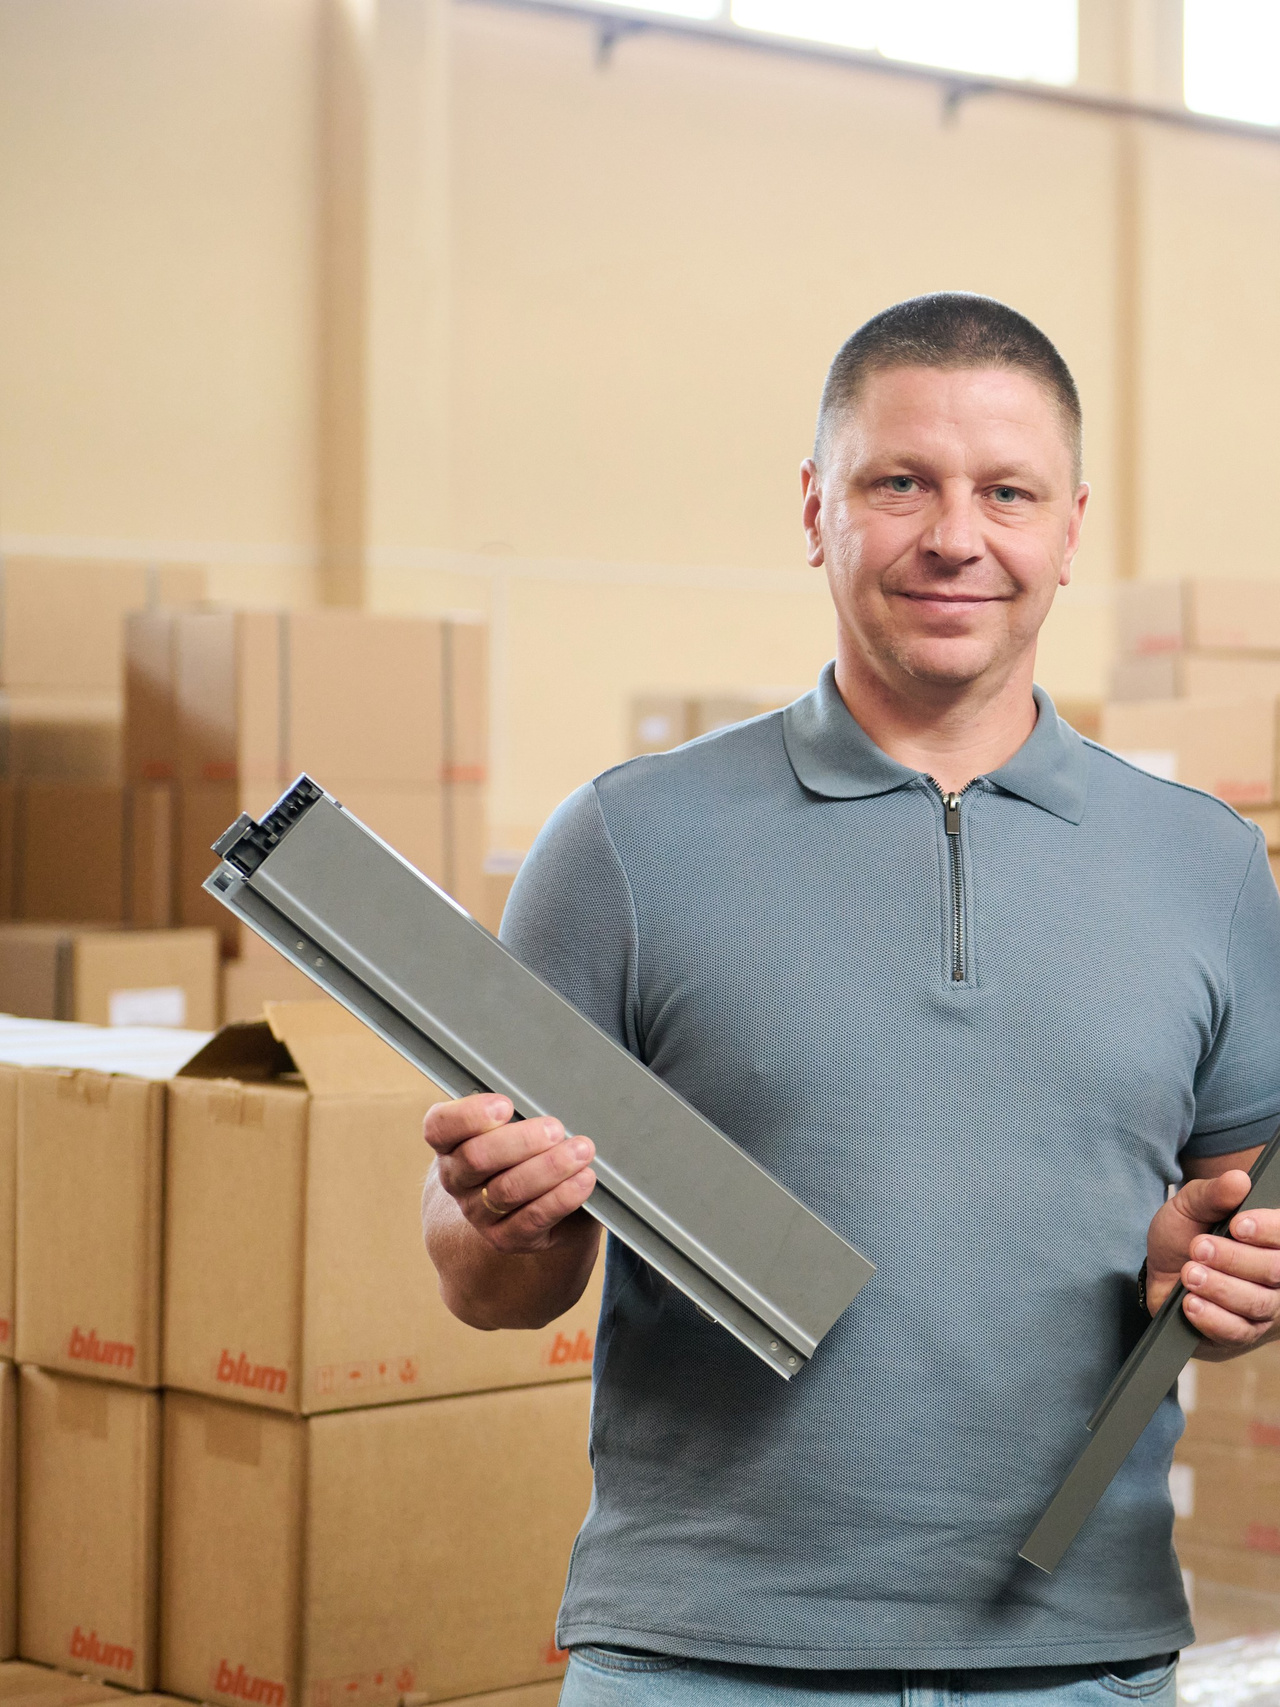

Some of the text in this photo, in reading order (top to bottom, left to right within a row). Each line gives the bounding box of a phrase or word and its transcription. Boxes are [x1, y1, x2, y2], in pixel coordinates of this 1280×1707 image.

[69, 1328, 136, 1370] blum
[548, 1331, 594, 1366] blu
[217, 1350, 289, 1394] blum
[70, 1627, 135, 1672] blum
[214, 1660, 286, 1707] blum
